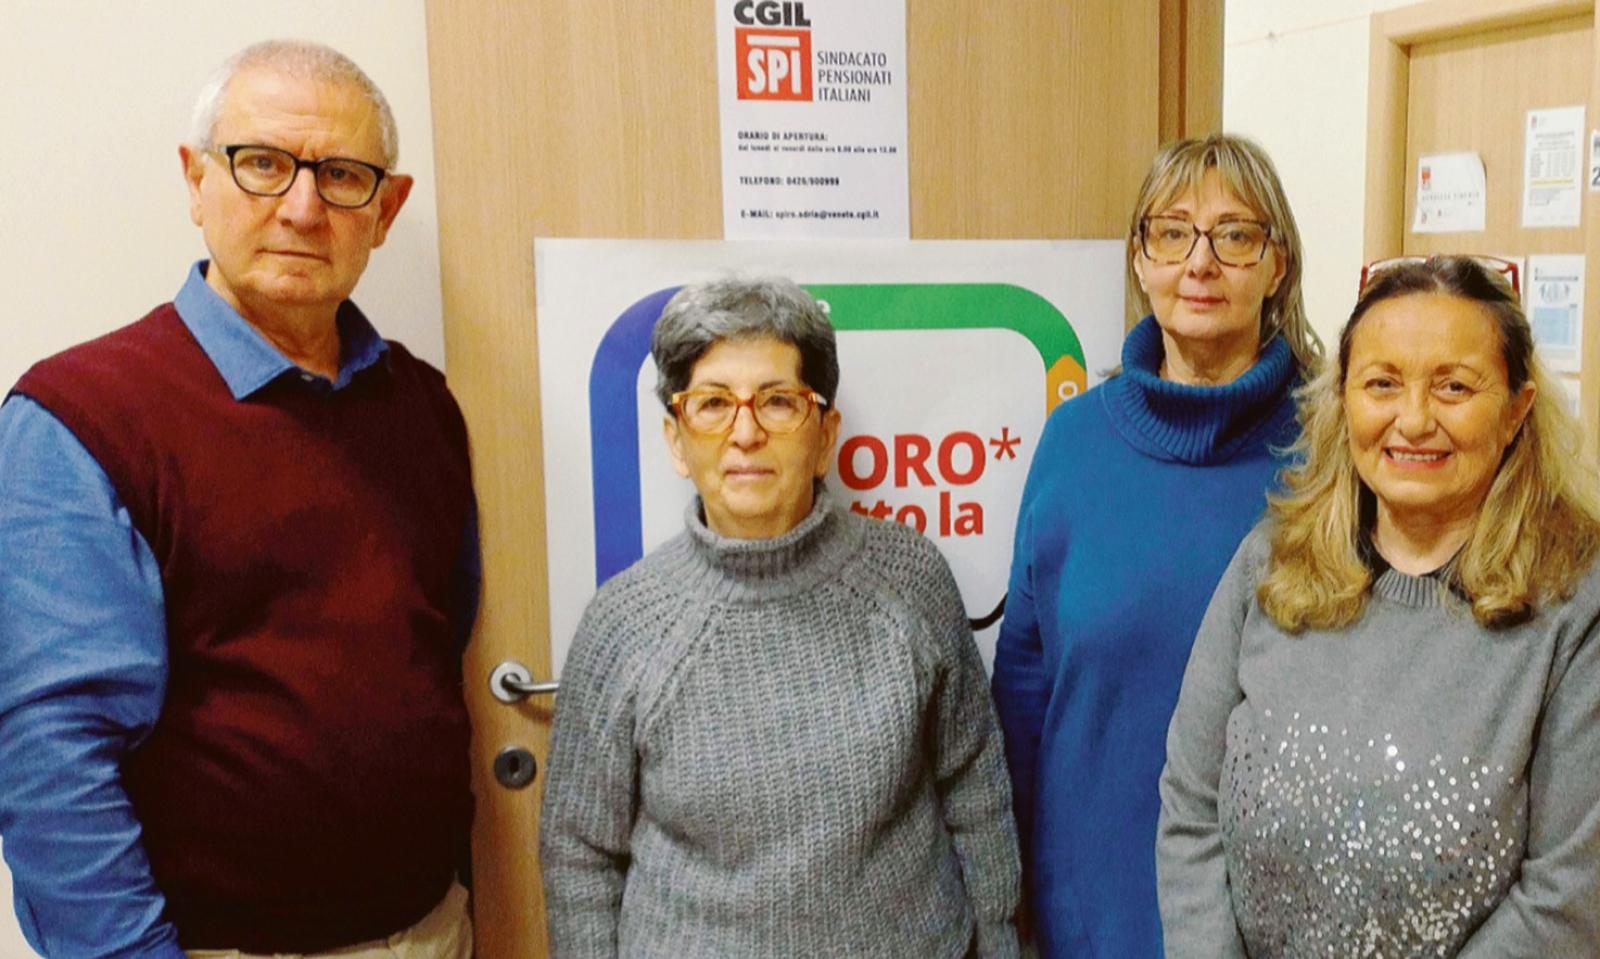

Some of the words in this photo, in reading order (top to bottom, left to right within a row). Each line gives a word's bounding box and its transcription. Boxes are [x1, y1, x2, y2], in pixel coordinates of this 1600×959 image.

[733, 0, 811, 27] CGIL
[817, 51, 887, 67] SINDACATO
[747, 48, 802, 94] SPI
[818, 69, 892, 85] PENSIONATI
[818, 87, 871, 102] ITALIANI
[738, 131, 770, 141] ORARIO
[772, 132, 782, 141] DI
[783, 132, 829, 142] APERTURA:
[739, 176, 784, 185] TELEFONO:
[740, 209, 774, 219] E-MAIL:
[939, 491, 984, 537] la
